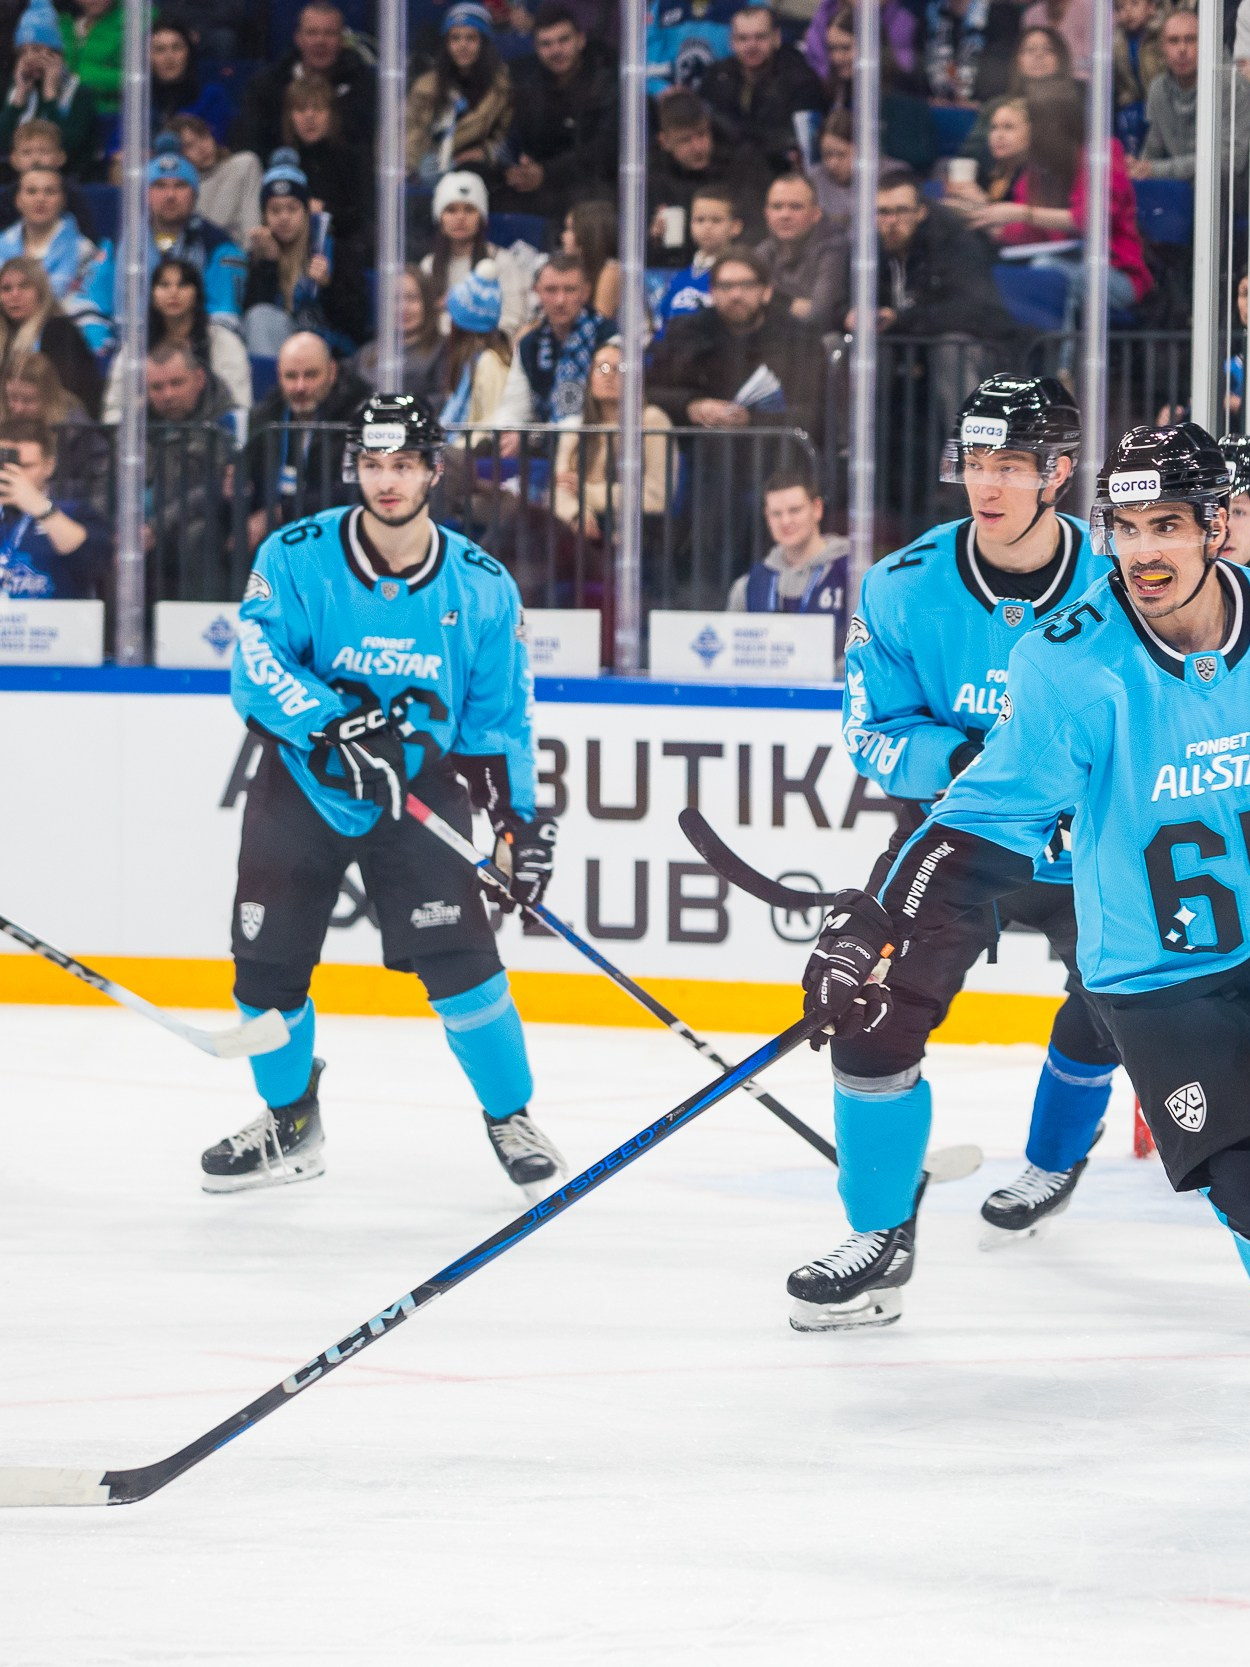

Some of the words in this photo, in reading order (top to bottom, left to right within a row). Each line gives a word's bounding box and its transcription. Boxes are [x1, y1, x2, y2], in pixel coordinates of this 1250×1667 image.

[964, 423, 1003, 438] согаз
[1111, 479, 1157, 493] согаз
[818, 586, 845, 610] 61
[361, 636, 416, 651] FONBET
[1186, 732, 1250, 759] FONBET
[821, 977, 829, 1005] CCM
[522, 1129, 655, 1229] JETSPEED
[282, 1292, 416, 1394] CCM
